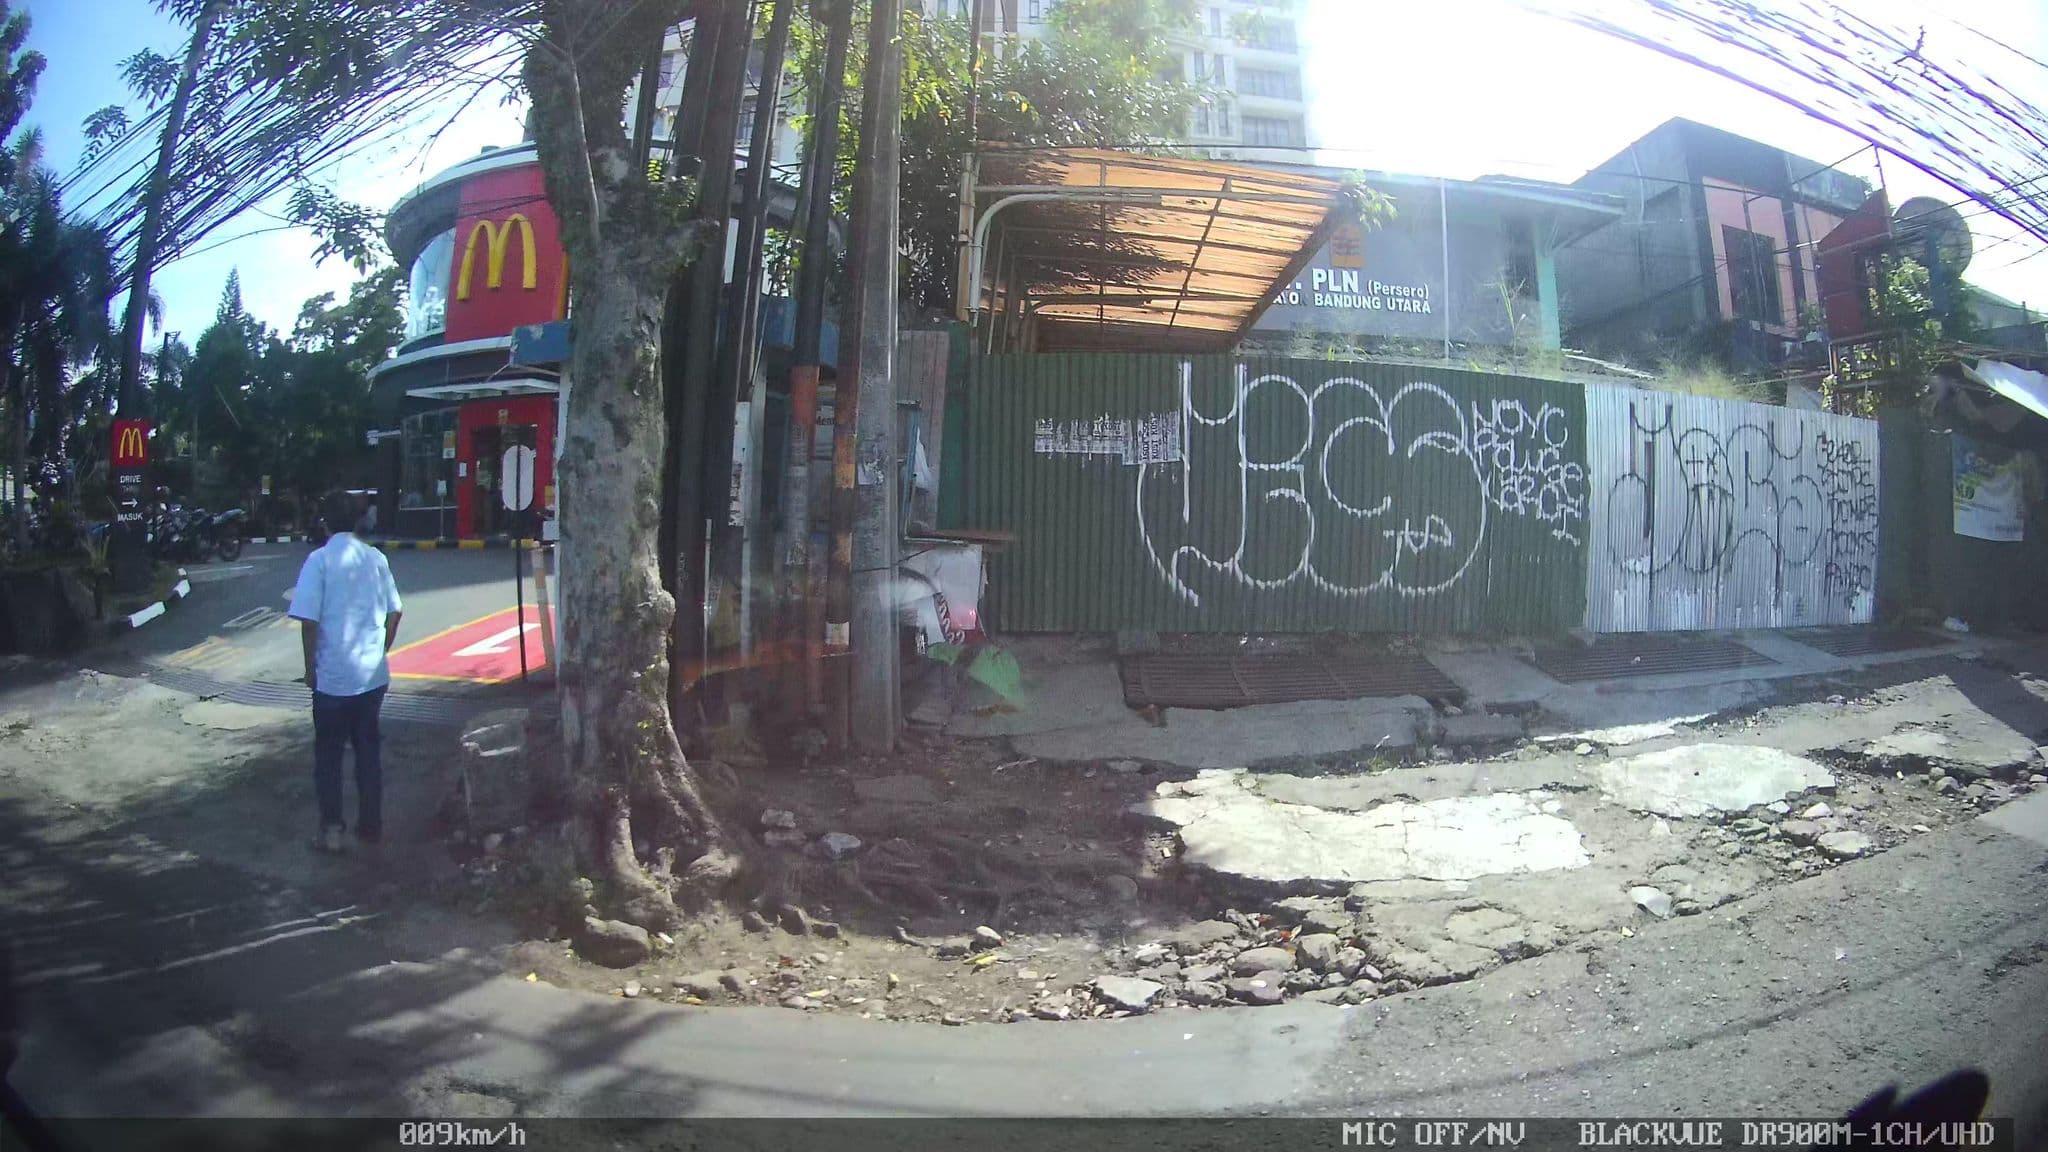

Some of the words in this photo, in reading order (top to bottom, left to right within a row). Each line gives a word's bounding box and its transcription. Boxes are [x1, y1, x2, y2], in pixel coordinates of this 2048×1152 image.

[1312, 268, 1359, 293] PLN
[1368, 279, 1429, 299] (Persero)
[1314, 292, 1381, 309] BANDUNG
[1387, 298, 1432, 314] UTARA
[119, 475, 142, 484] DRIVE
[117, 512, 144, 522] MASUK
